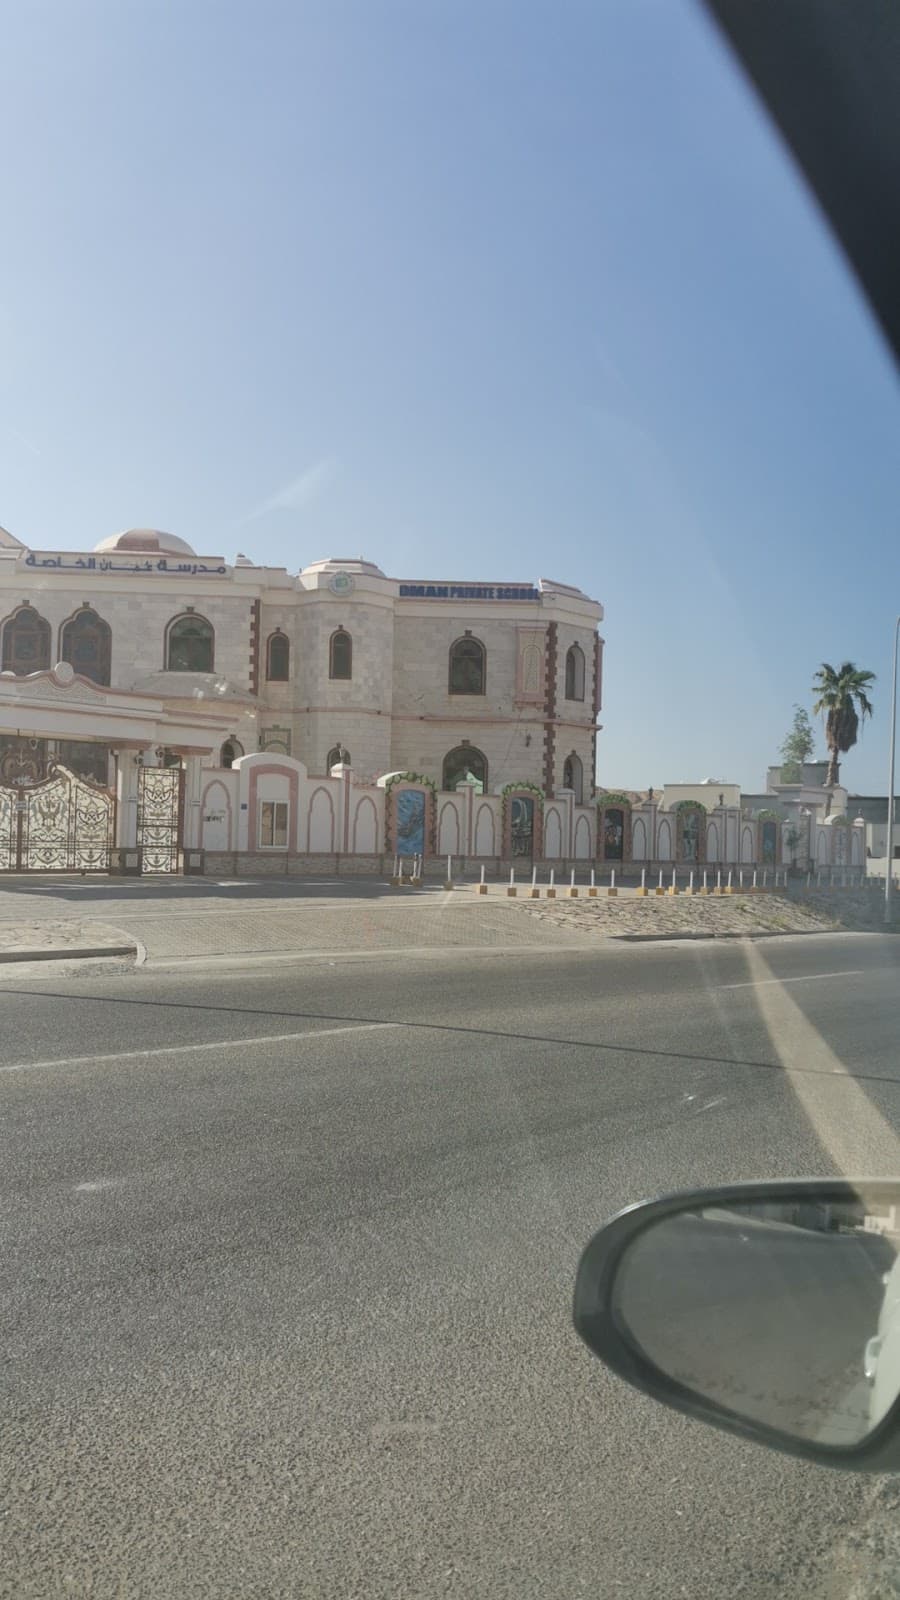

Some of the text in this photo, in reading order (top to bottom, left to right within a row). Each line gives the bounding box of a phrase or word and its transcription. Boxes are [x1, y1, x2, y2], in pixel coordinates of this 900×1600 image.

[25, 554, 96, 570] الخاصة
[157, 559, 227, 575] مدرسة
[400, 585, 448, 597] OMAN
